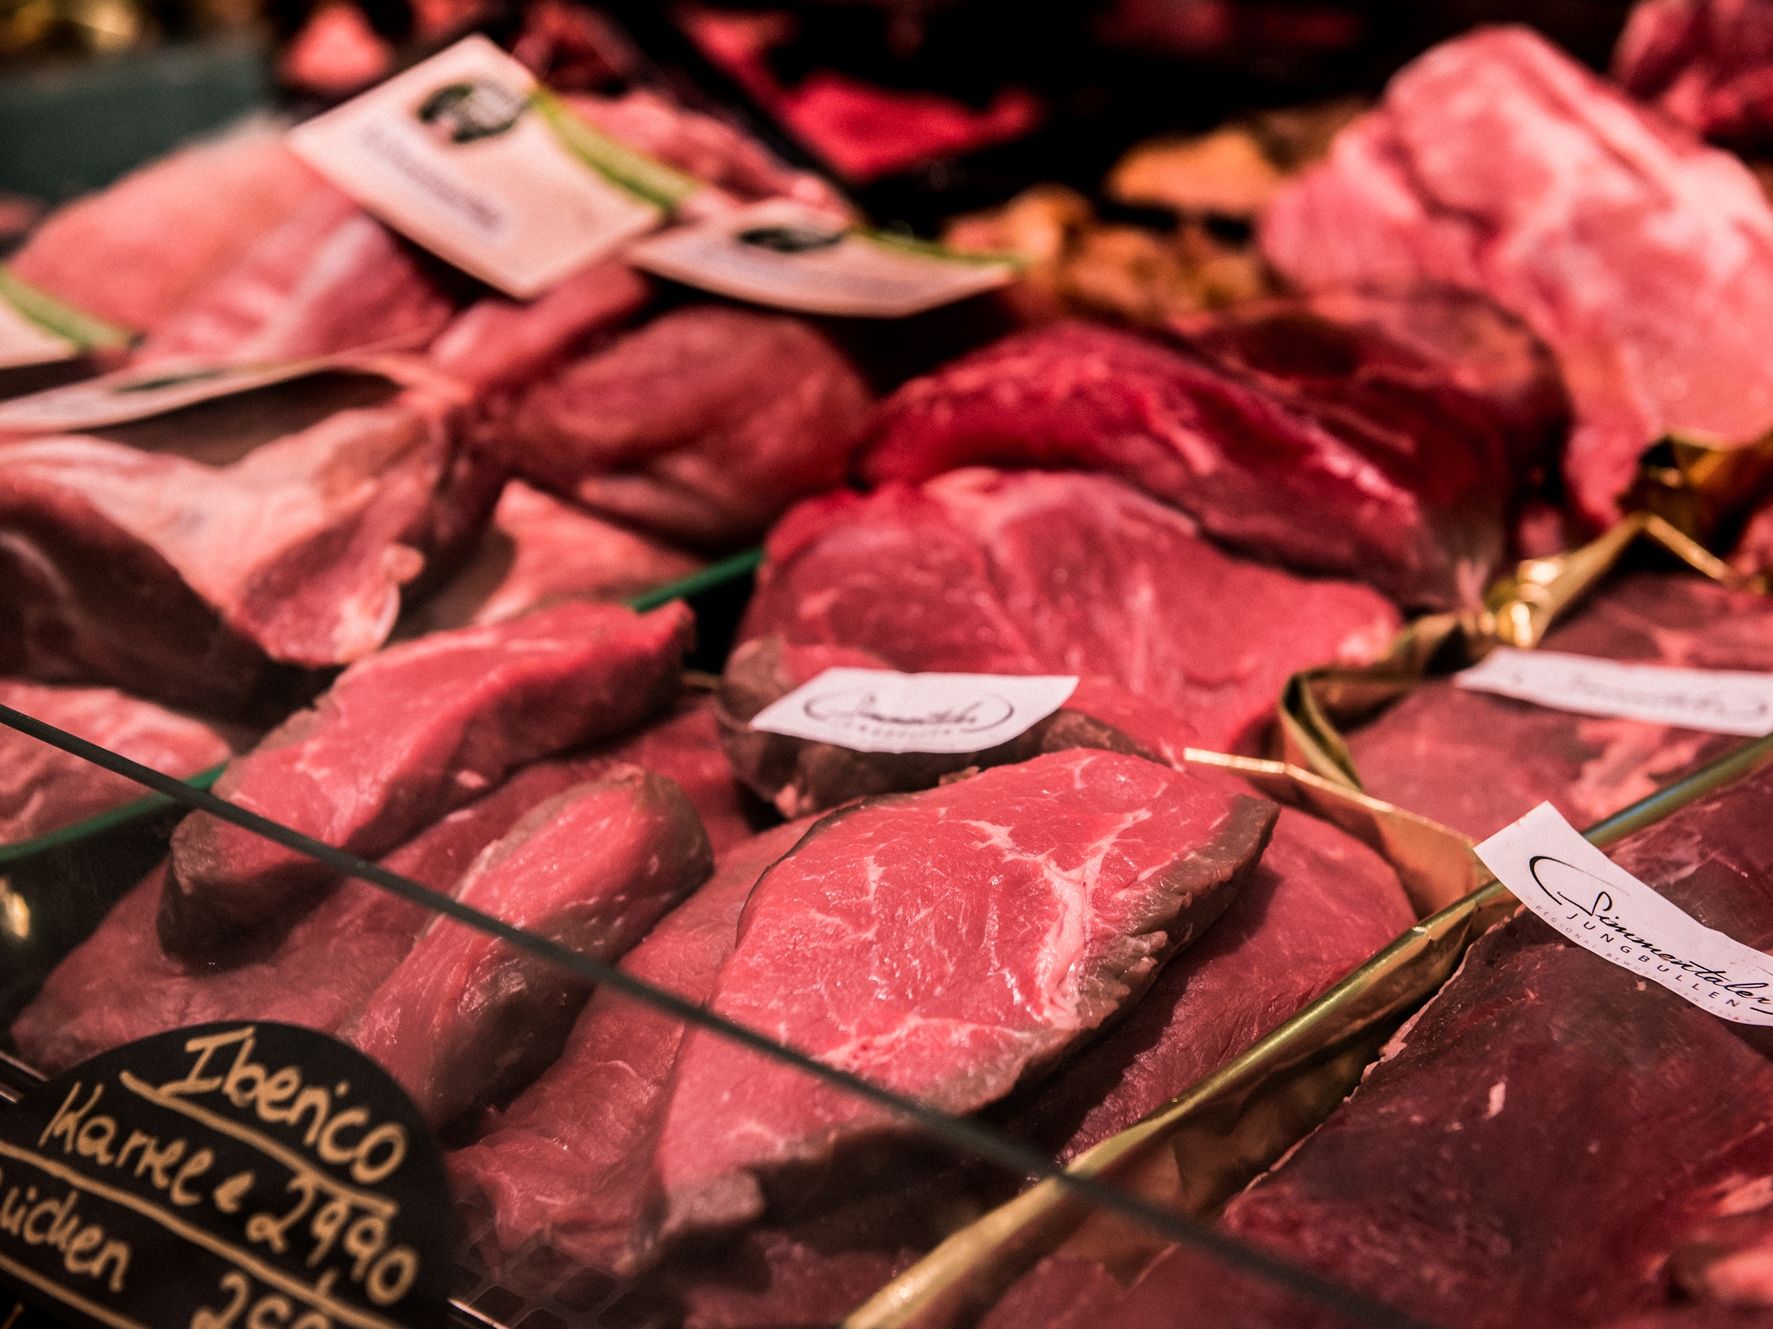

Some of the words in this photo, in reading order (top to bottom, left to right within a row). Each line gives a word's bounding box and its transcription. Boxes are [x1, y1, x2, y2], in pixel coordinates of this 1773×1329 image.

[1556, 891, 1772, 1004] Simmentaler
[1566, 913, 1740, 1007] JUNGBULLEN
[156, 1026, 408, 1184] Iberico
[0, 1180, 131, 1293] ücken
